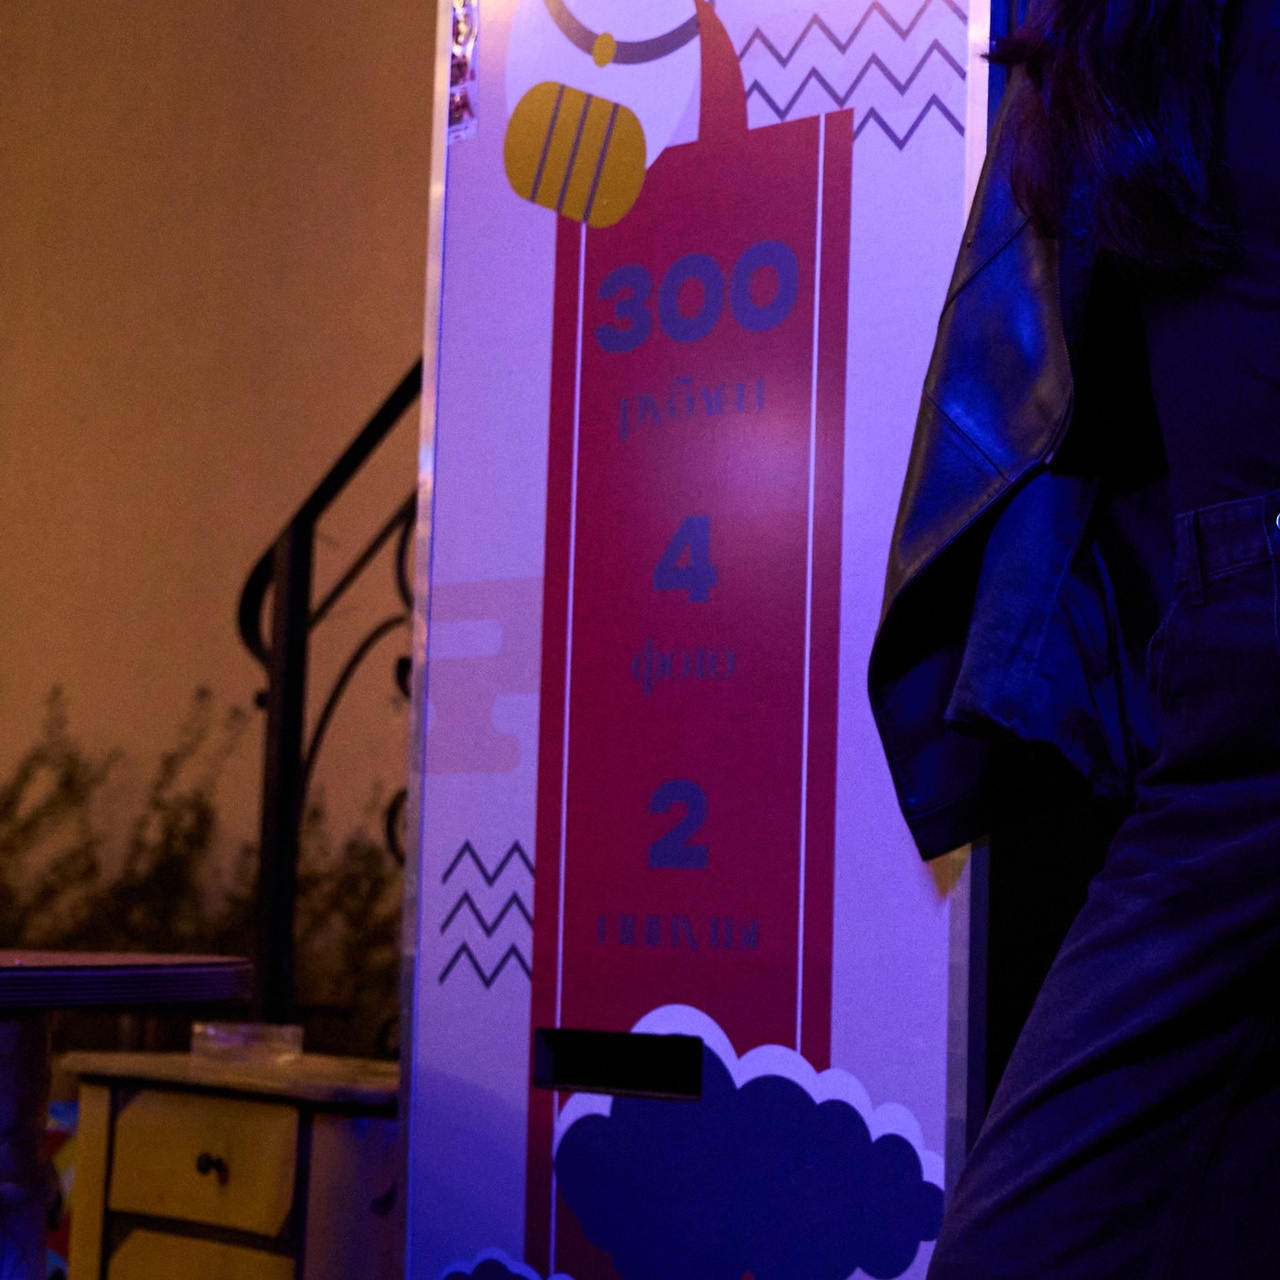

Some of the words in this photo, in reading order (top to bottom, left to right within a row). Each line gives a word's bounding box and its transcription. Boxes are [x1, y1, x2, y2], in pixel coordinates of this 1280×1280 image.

[594, 239, 799, 354] 300
[652, 514, 718, 604] 4
[631, 635, 735, 699] фото
[648, 778, 709, 869] 2
